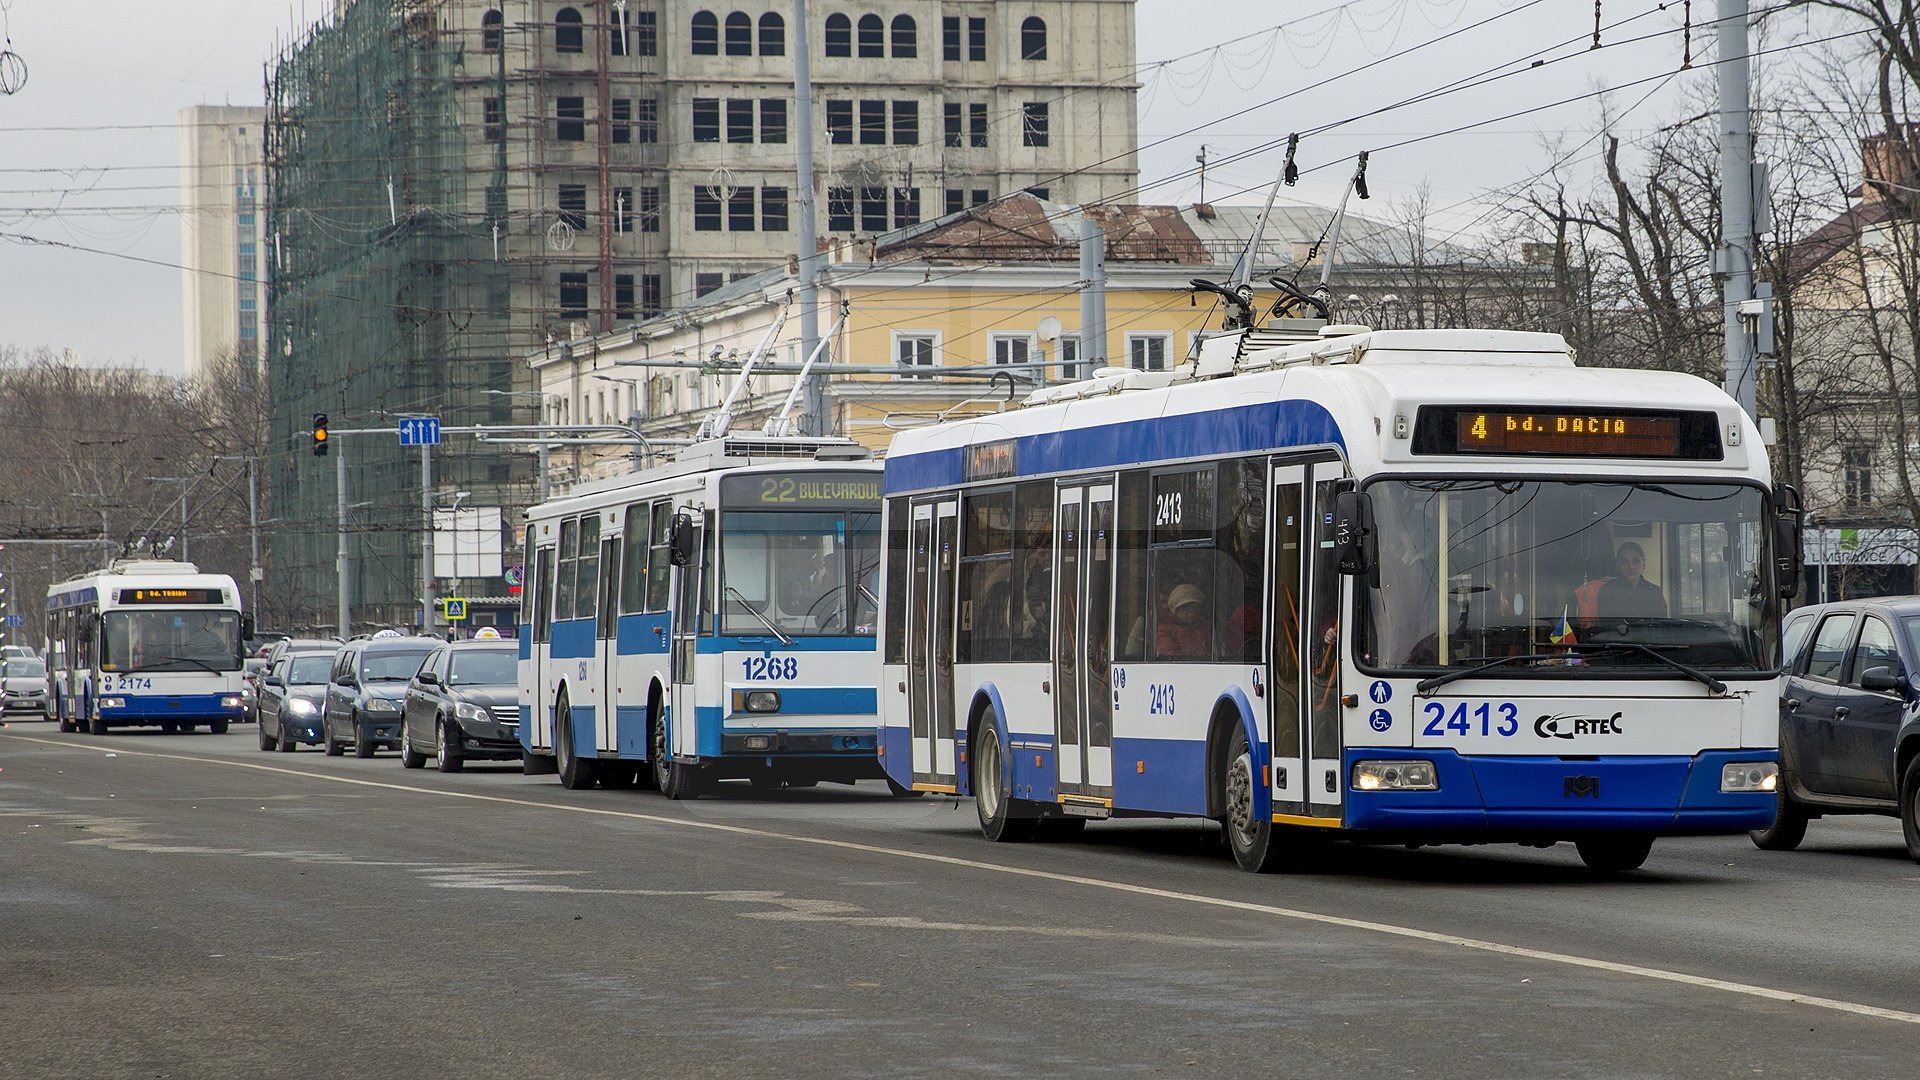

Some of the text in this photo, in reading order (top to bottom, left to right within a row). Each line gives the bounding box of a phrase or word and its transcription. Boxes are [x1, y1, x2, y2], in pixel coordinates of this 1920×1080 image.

[1471, 415, 1487, 439] 4
[1557, 417, 1625, 434] DACIA
[761, 477, 881, 502] 22 BULEVARDUL
[1155, 492, 1182, 526] 2413
[136, 590, 144, 600] 8
[742, 657, 798, 681] 1268
[119, 677, 152, 690] 2174
[1149, 683, 1175, 716] 2413
[1422, 702, 1519, 737] 2413
